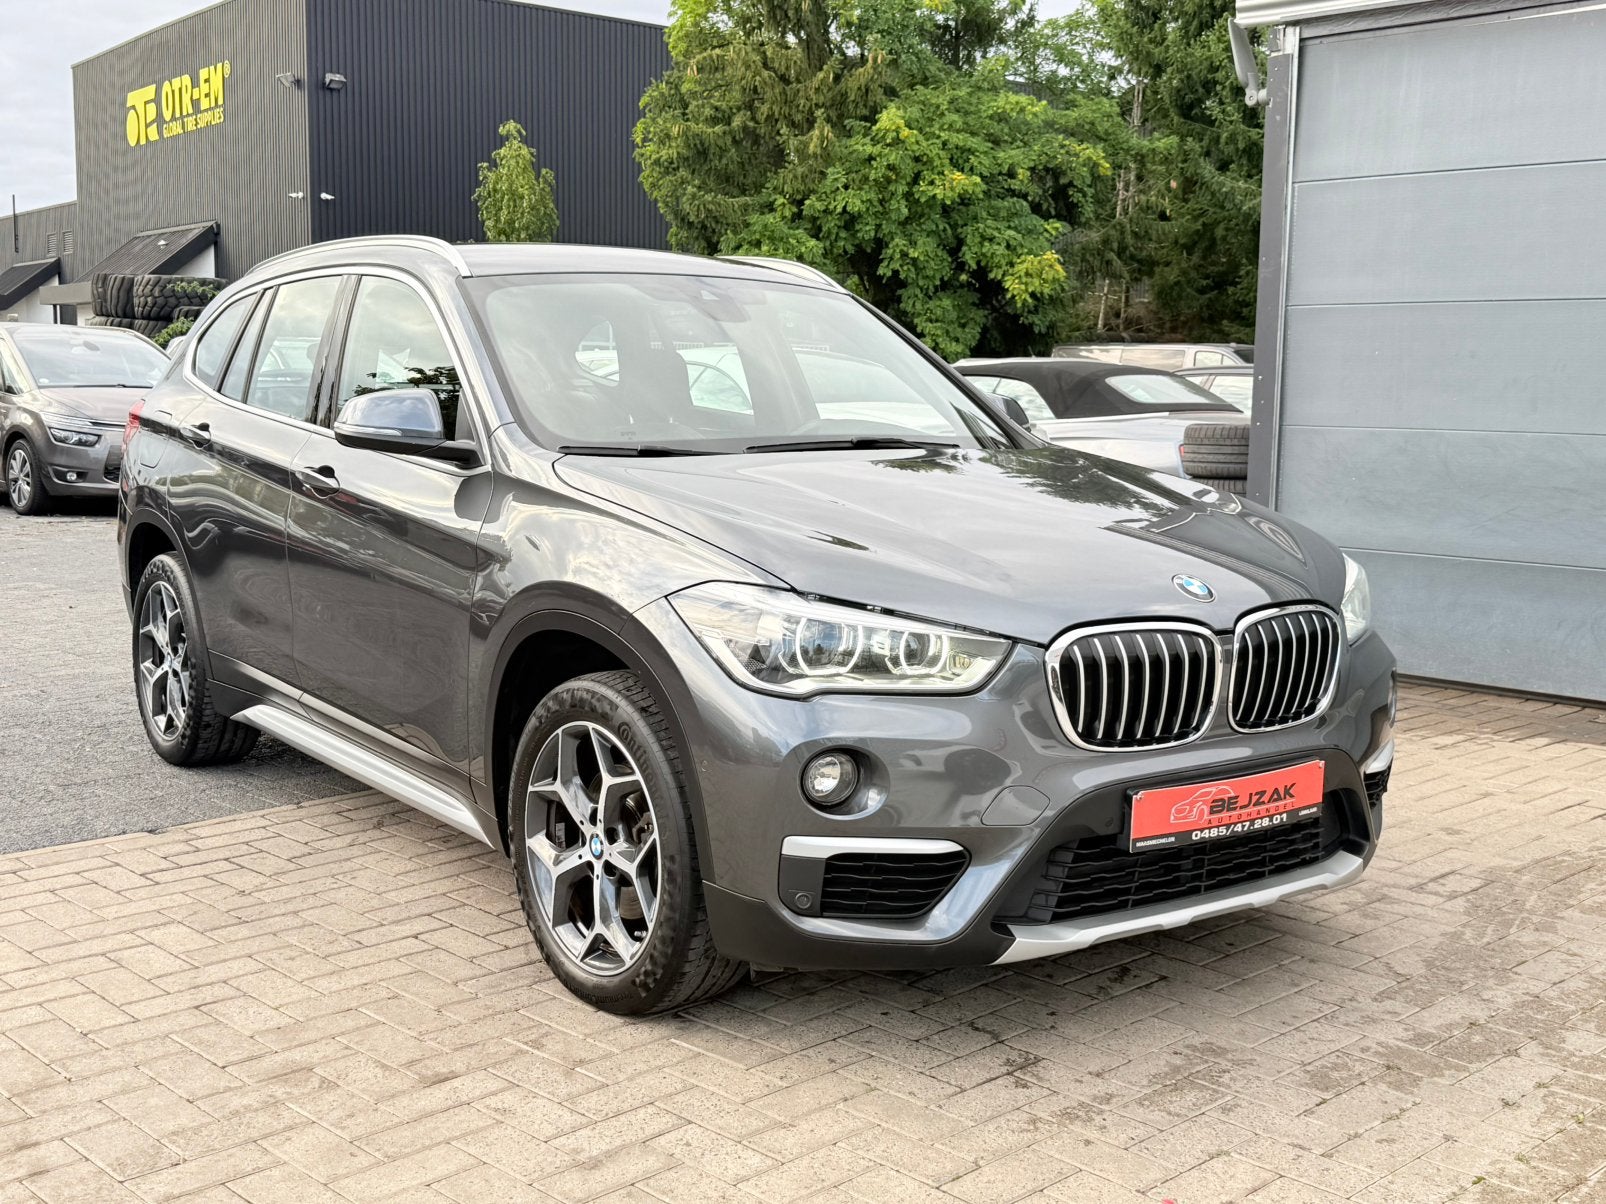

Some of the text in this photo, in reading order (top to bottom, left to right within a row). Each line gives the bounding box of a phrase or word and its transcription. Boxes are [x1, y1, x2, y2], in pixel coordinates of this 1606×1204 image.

[163, 107, 225, 138] GLOBAL TIRE SUPPLIES
[1207, 802, 1295, 825] AUTOHANDEL
[1209, 783, 1297, 815] BEJZAK
[1191, 813, 1287, 840] 0485/47.28.01
